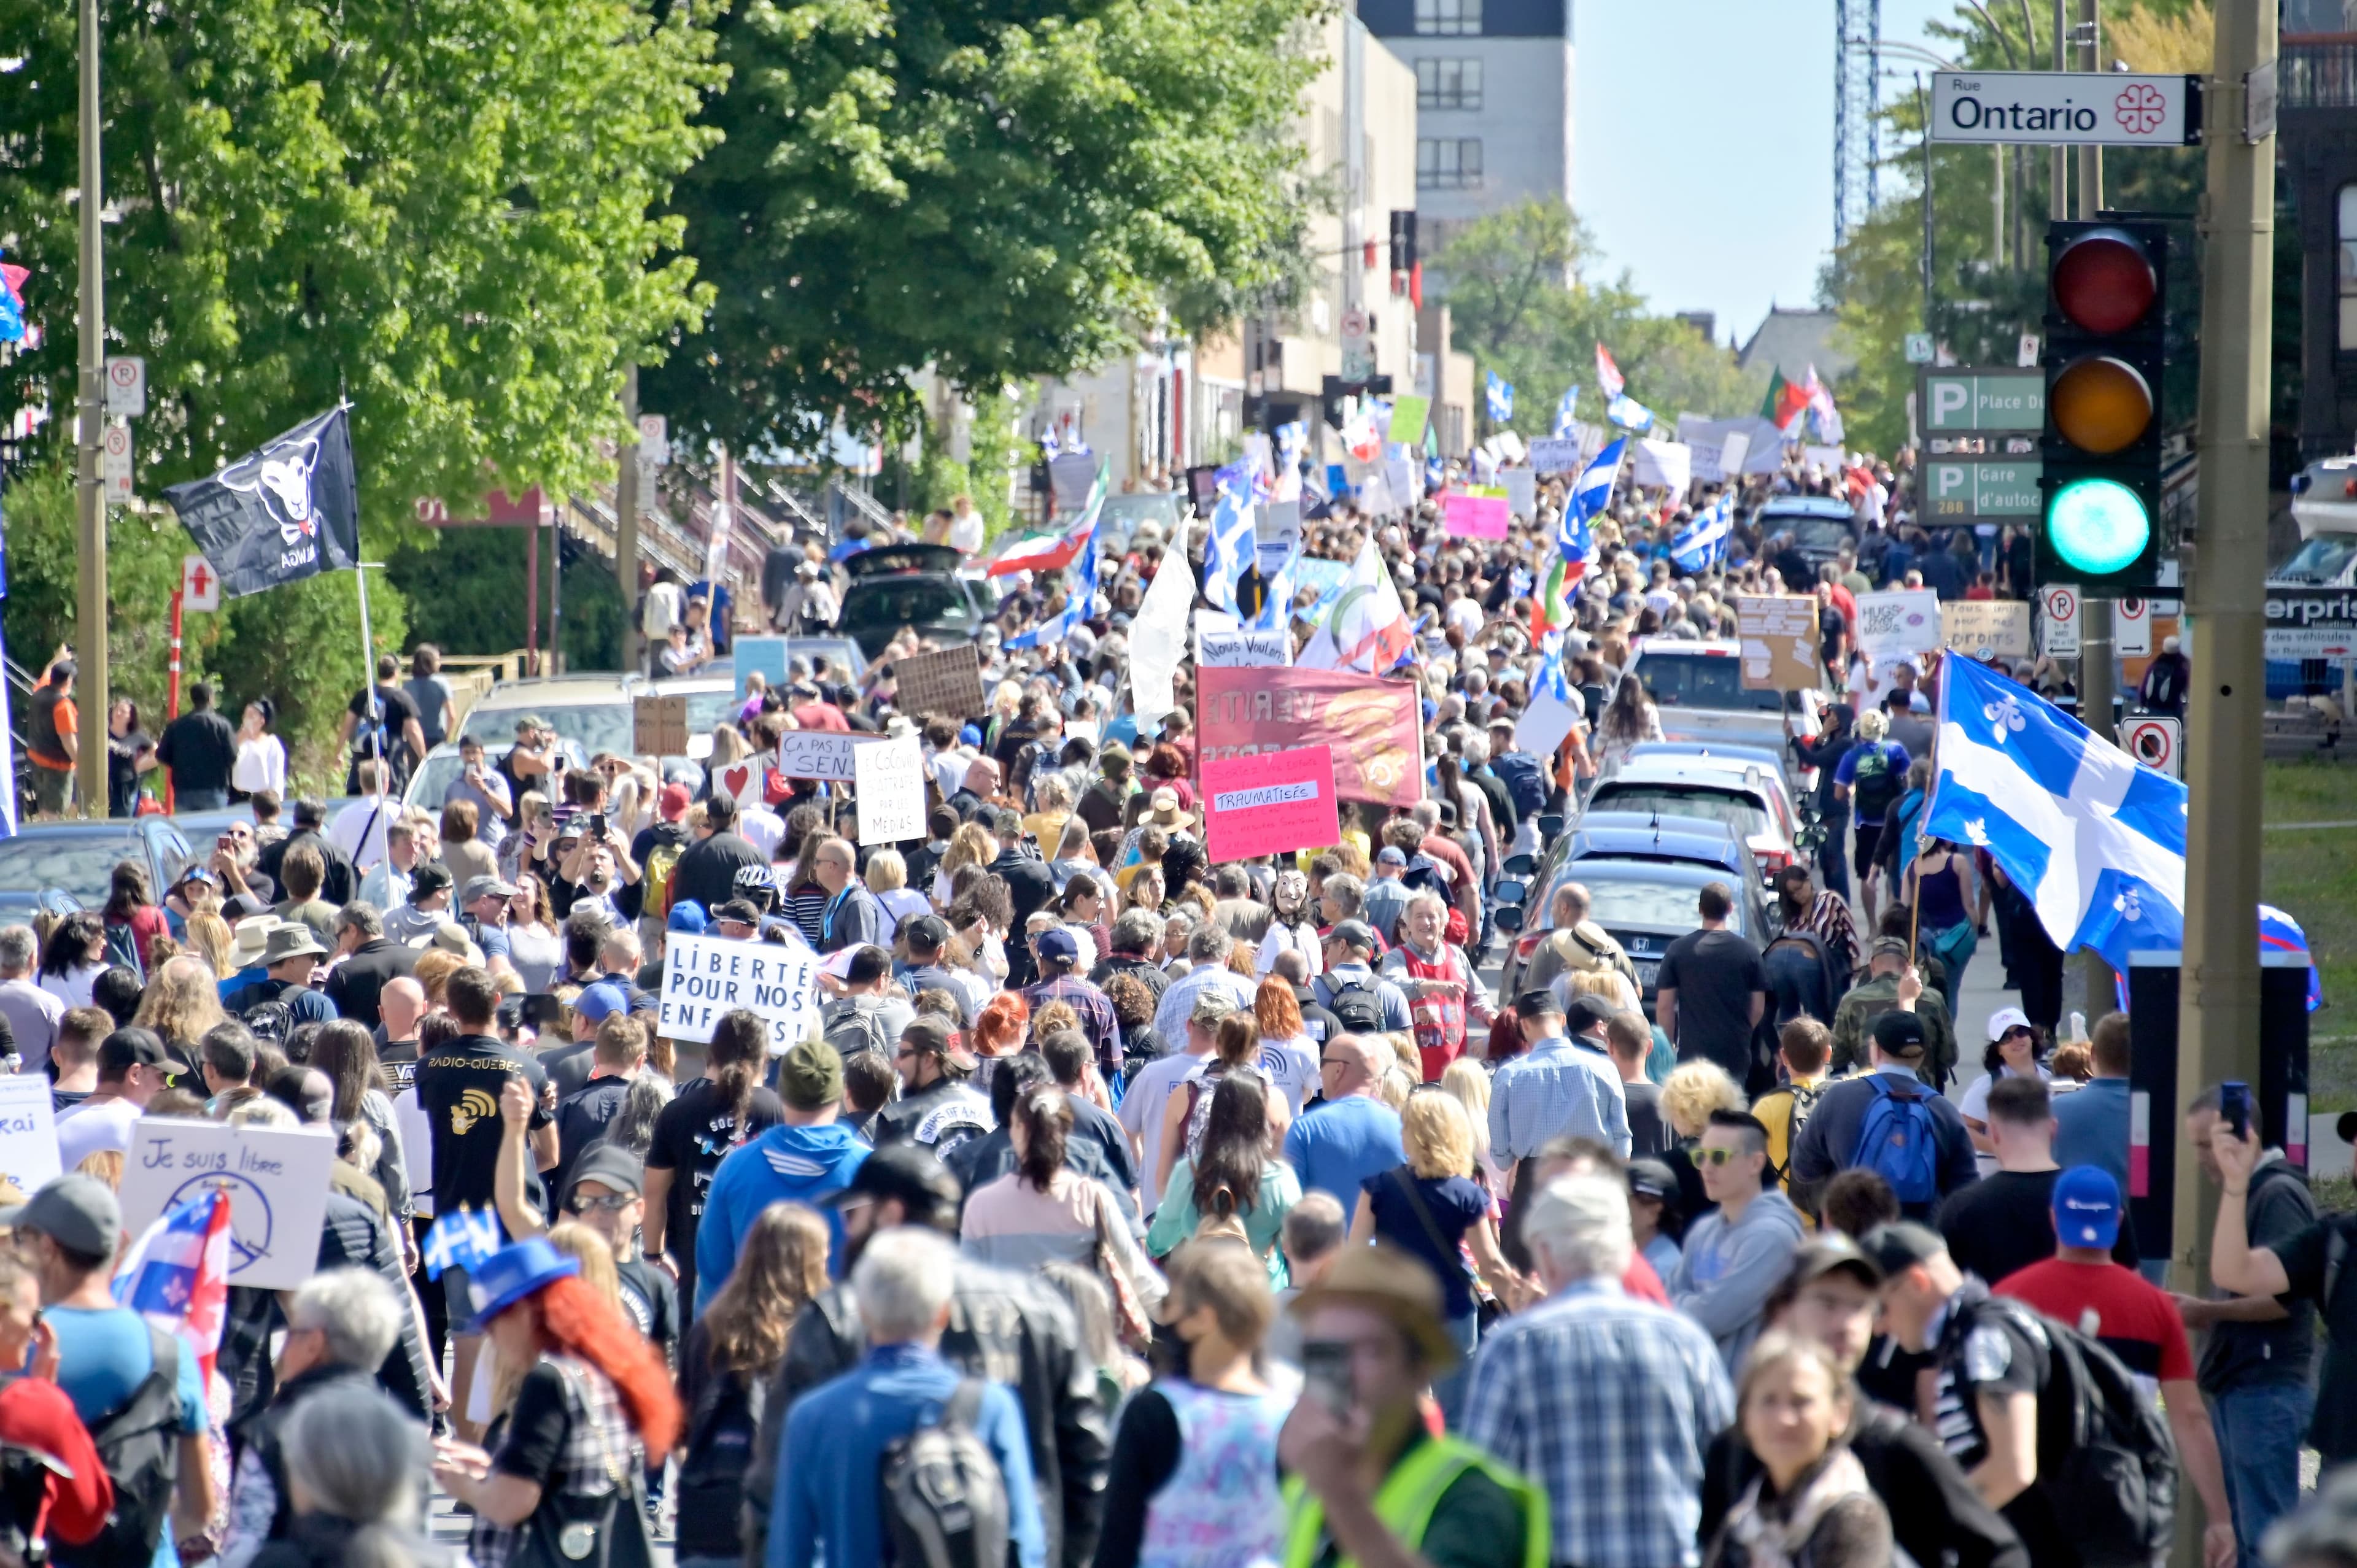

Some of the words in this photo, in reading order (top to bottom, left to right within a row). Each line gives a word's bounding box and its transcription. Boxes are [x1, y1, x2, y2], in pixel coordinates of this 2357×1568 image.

[1953, 79, 1981, 91] Rue
[1952, 96, 2097, 131] Ontario
[1934, 382, 1967, 425] P
[1980, 395, 2021, 409] Place
[1980, 469, 2015, 482] Gare
[1980, 492, 2042, 507] d'autoc
[1862, 604, 1900, 619] HUGS
[1202, 641, 1240, 662] Nous
[1245, 636, 1287, 664] Voulons
[811, 740, 832, 752] PAS
[1218, 785, 1309, 809] TRAUMATISÉS
[671, 973, 738, 1003] POUR
[755, 984, 803, 1012] NOS
[394, 1064, 416, 1080] VA
[709, 1117, 753, 1133] SOCL
[142, 1139, 174, 1169] Je
[183, 1151, 227, 1170] suis
